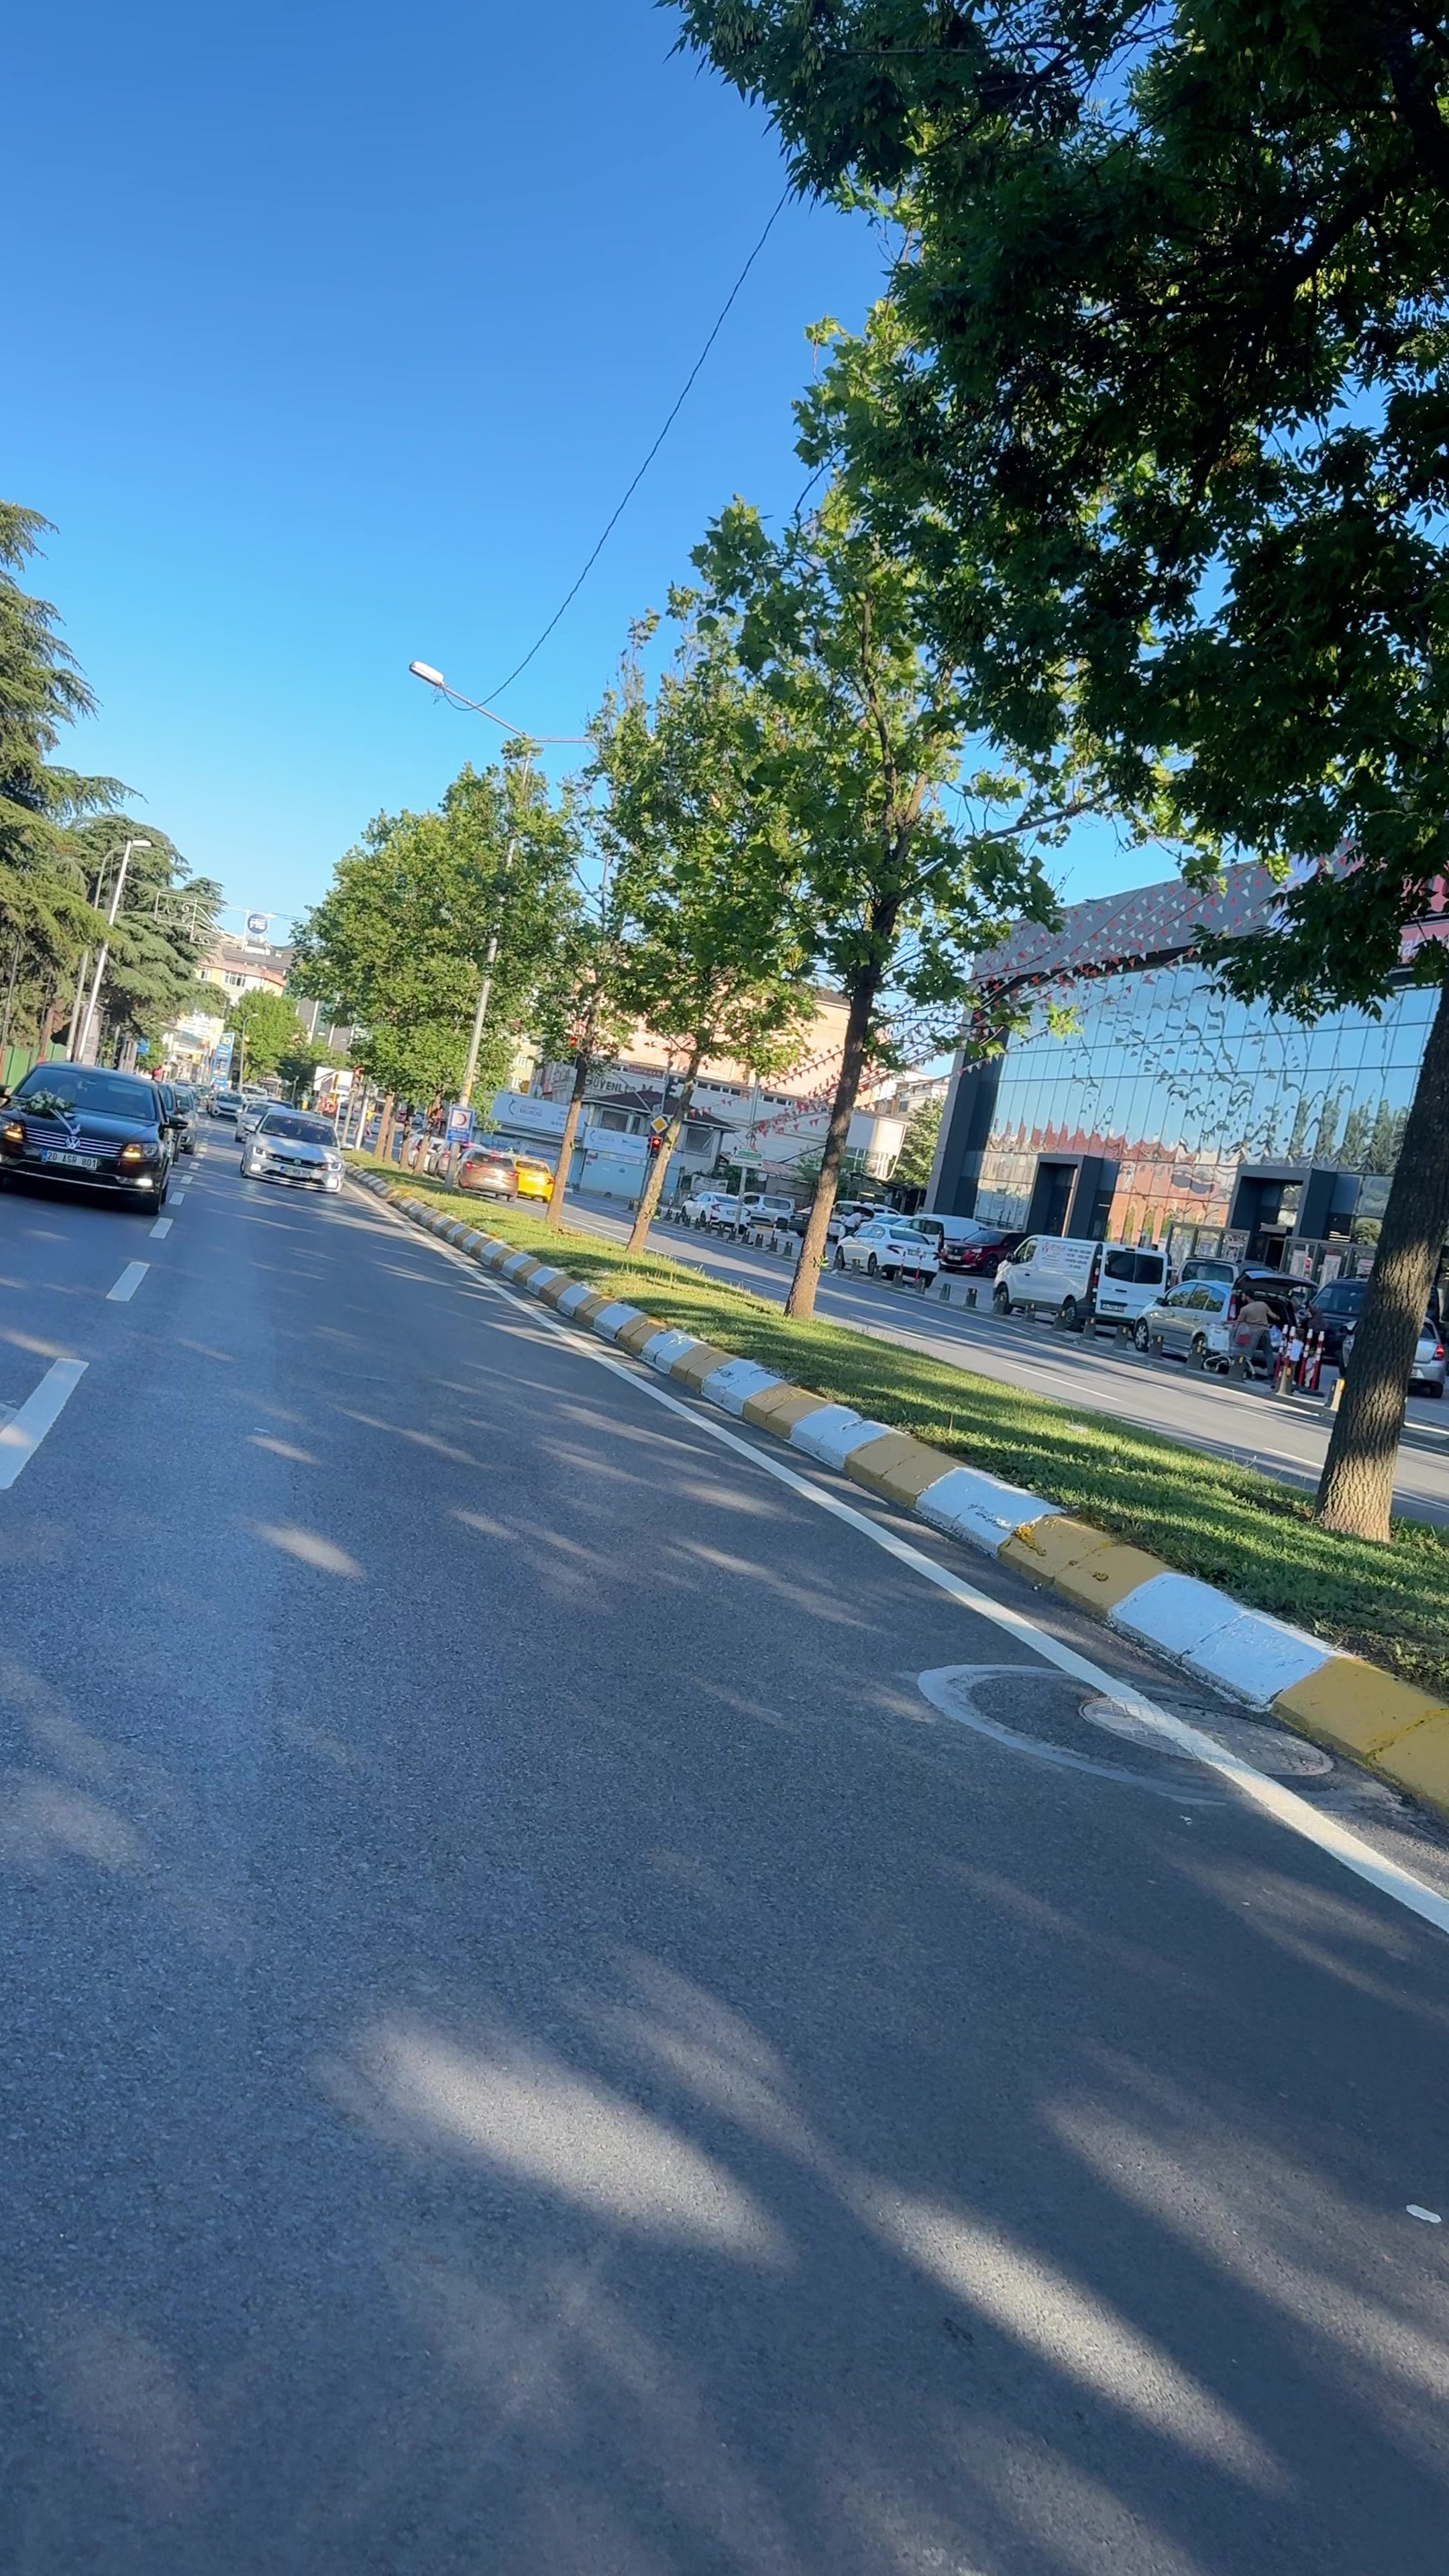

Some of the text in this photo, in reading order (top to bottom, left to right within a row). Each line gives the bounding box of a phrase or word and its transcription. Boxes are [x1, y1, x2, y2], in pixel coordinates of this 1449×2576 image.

[48, 1152, 97, 1168] 20 ASR 801
